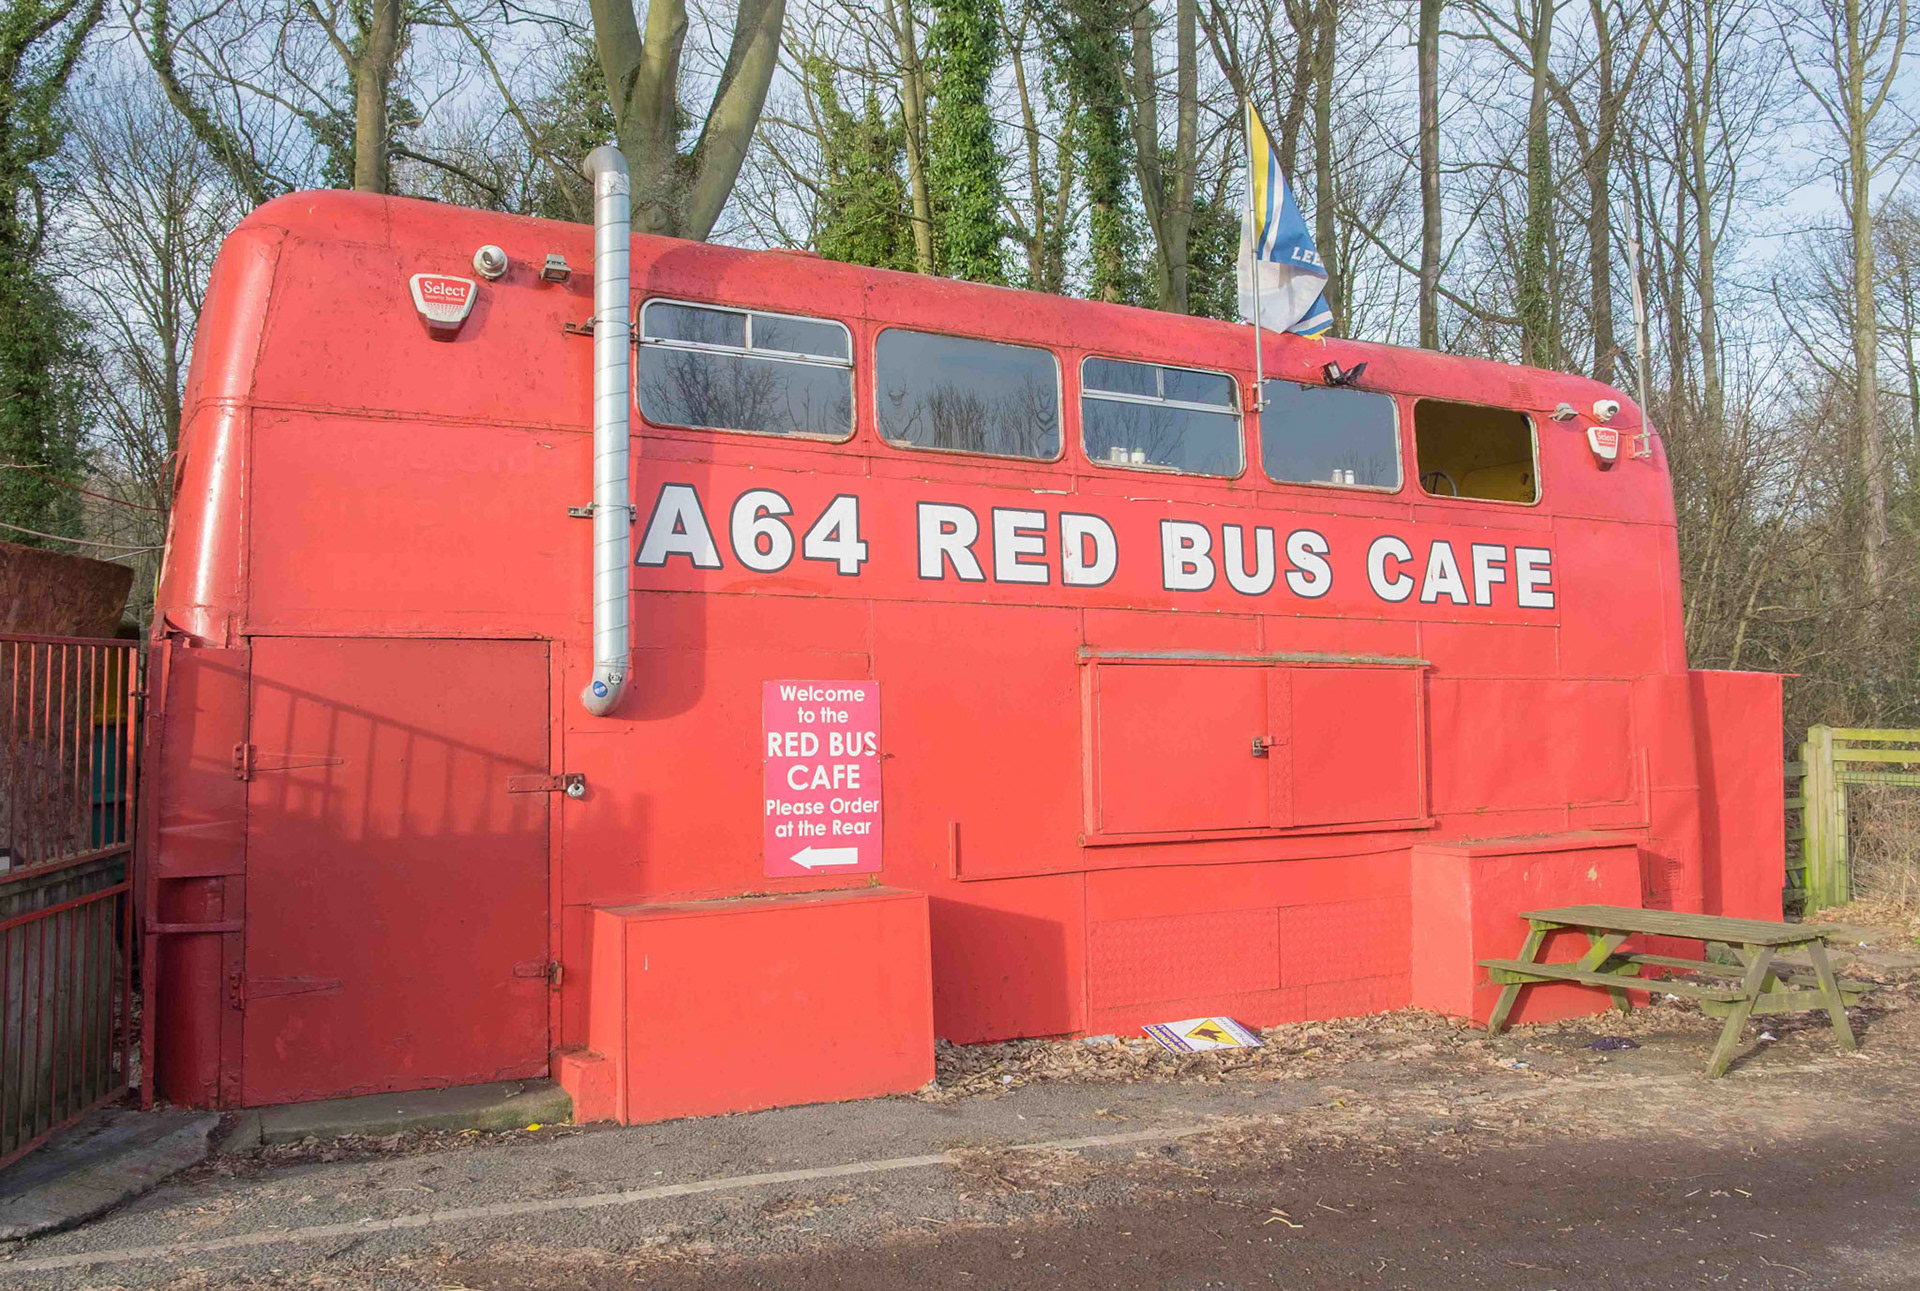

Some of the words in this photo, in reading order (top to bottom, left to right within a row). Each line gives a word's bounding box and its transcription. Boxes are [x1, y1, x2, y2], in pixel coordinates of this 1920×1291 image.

[424, 281, 466, 297] Select
[634, 482, 868, 577] A64
[916, 500, 1118, 587] RED
[1160, 518, 1333, 599] BUS
[1366, 535, 1556, 609] CAFE
[780, 685, 865, 702] Welcome
[798, 707, 816, 724] to
[820, 706, 849, 724] the
[767, 731, 819, 757] RED
[829, 731, 878, 757] BUS
[787, 764, 861, 790] CAFE
[766, 798, 825, 816] Please
[829, 797, 880, 815] Order
[775, 821, 793, 838] at
[798, 820, 826, 837] the
[832, 819, 872, 836] Rear
